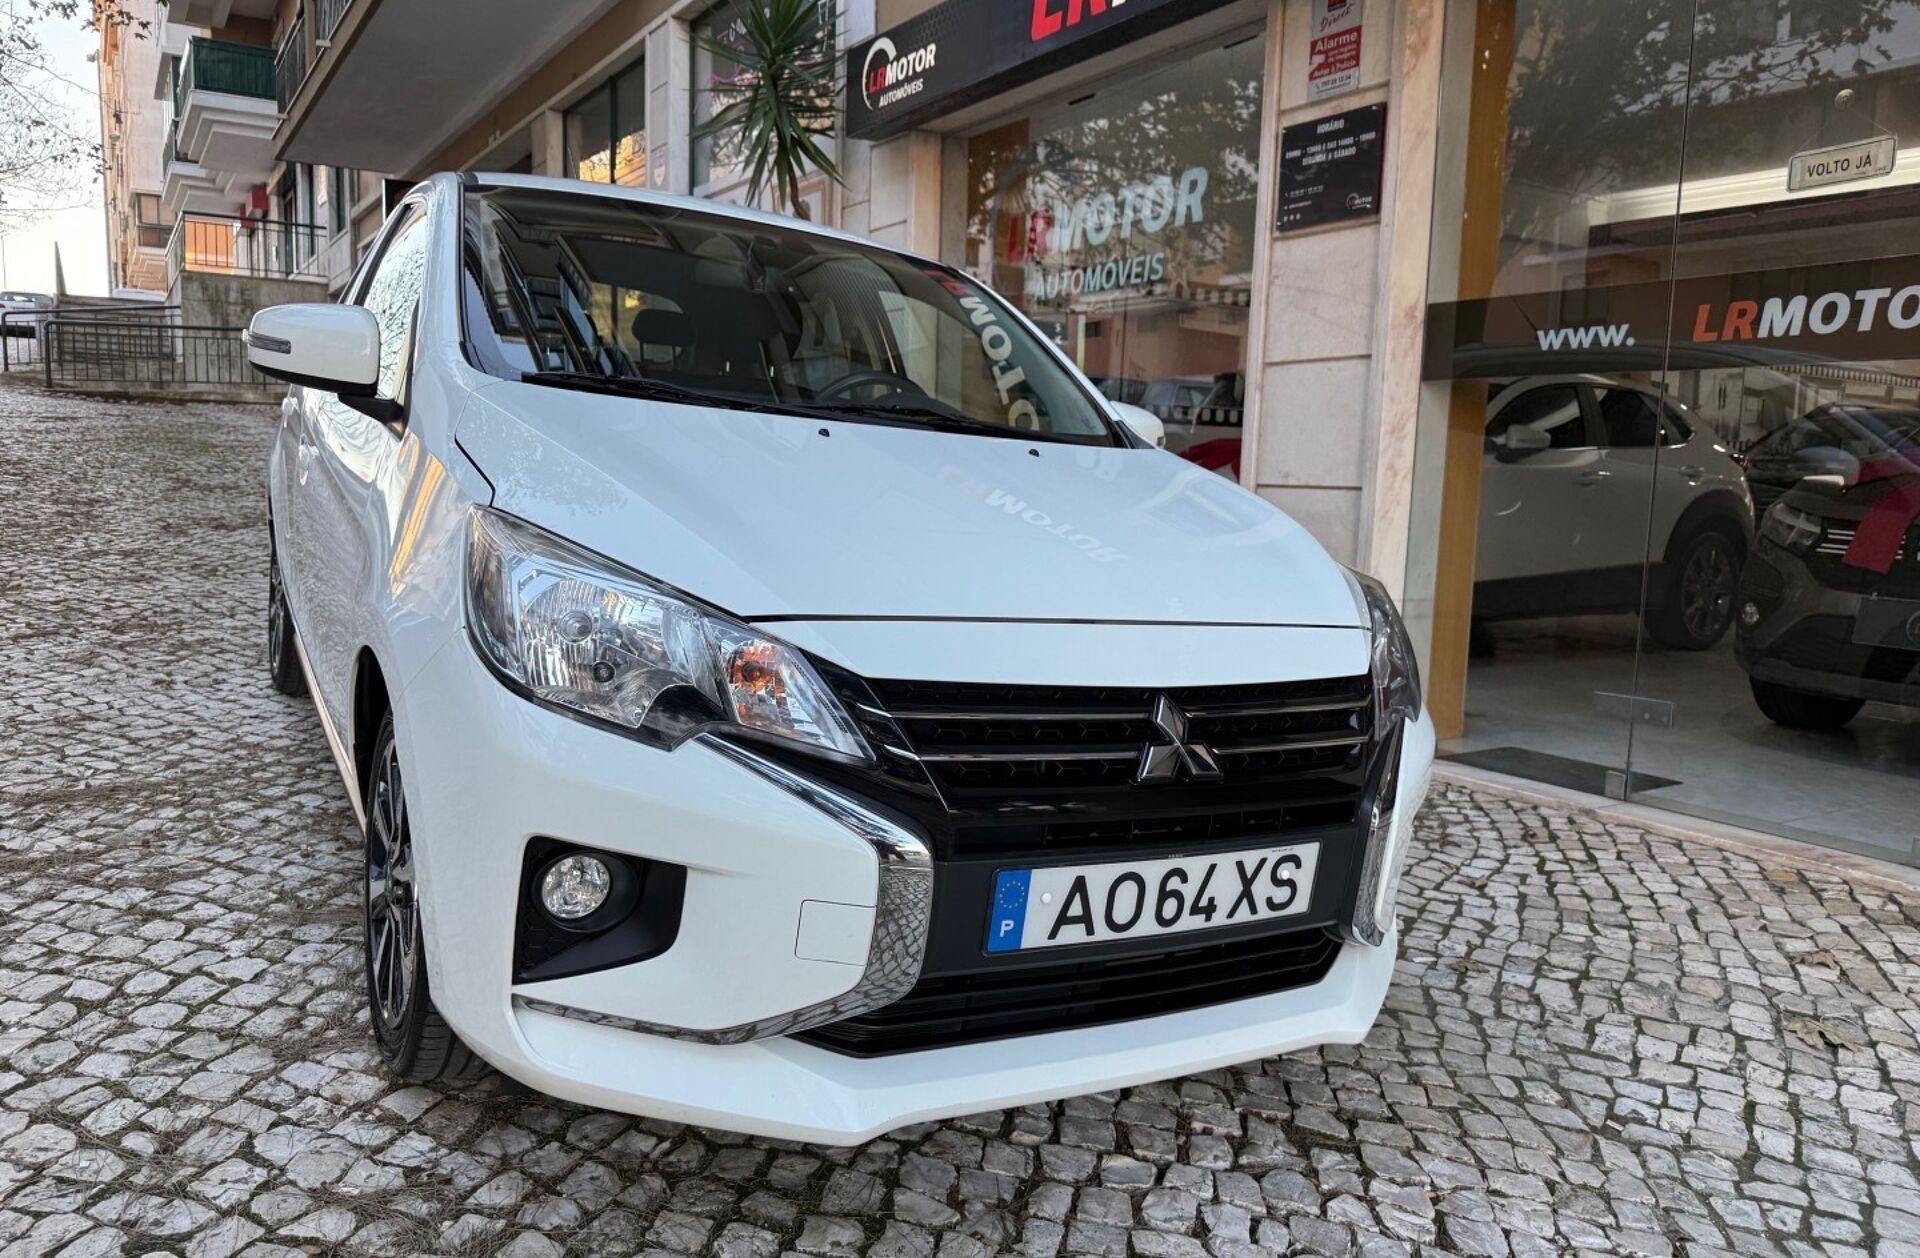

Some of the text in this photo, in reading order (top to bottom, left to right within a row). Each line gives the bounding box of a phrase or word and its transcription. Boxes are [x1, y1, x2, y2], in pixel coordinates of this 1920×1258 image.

[1315, 31, 1358, 53] Alarme
[868, 42, 936, 94] LRMOTOR
[879, 78, 923, 108] AUTOMÓVEIS
[1807, 158, 1850, 178] VOLTO
[1855, 150, 1873, 169] JÁ
[1008, 166, 1209, 263] LRMOTOR
[1536, 284, 1920, 351] www. LRMOTO
[999, 919, 1014, 938] P
